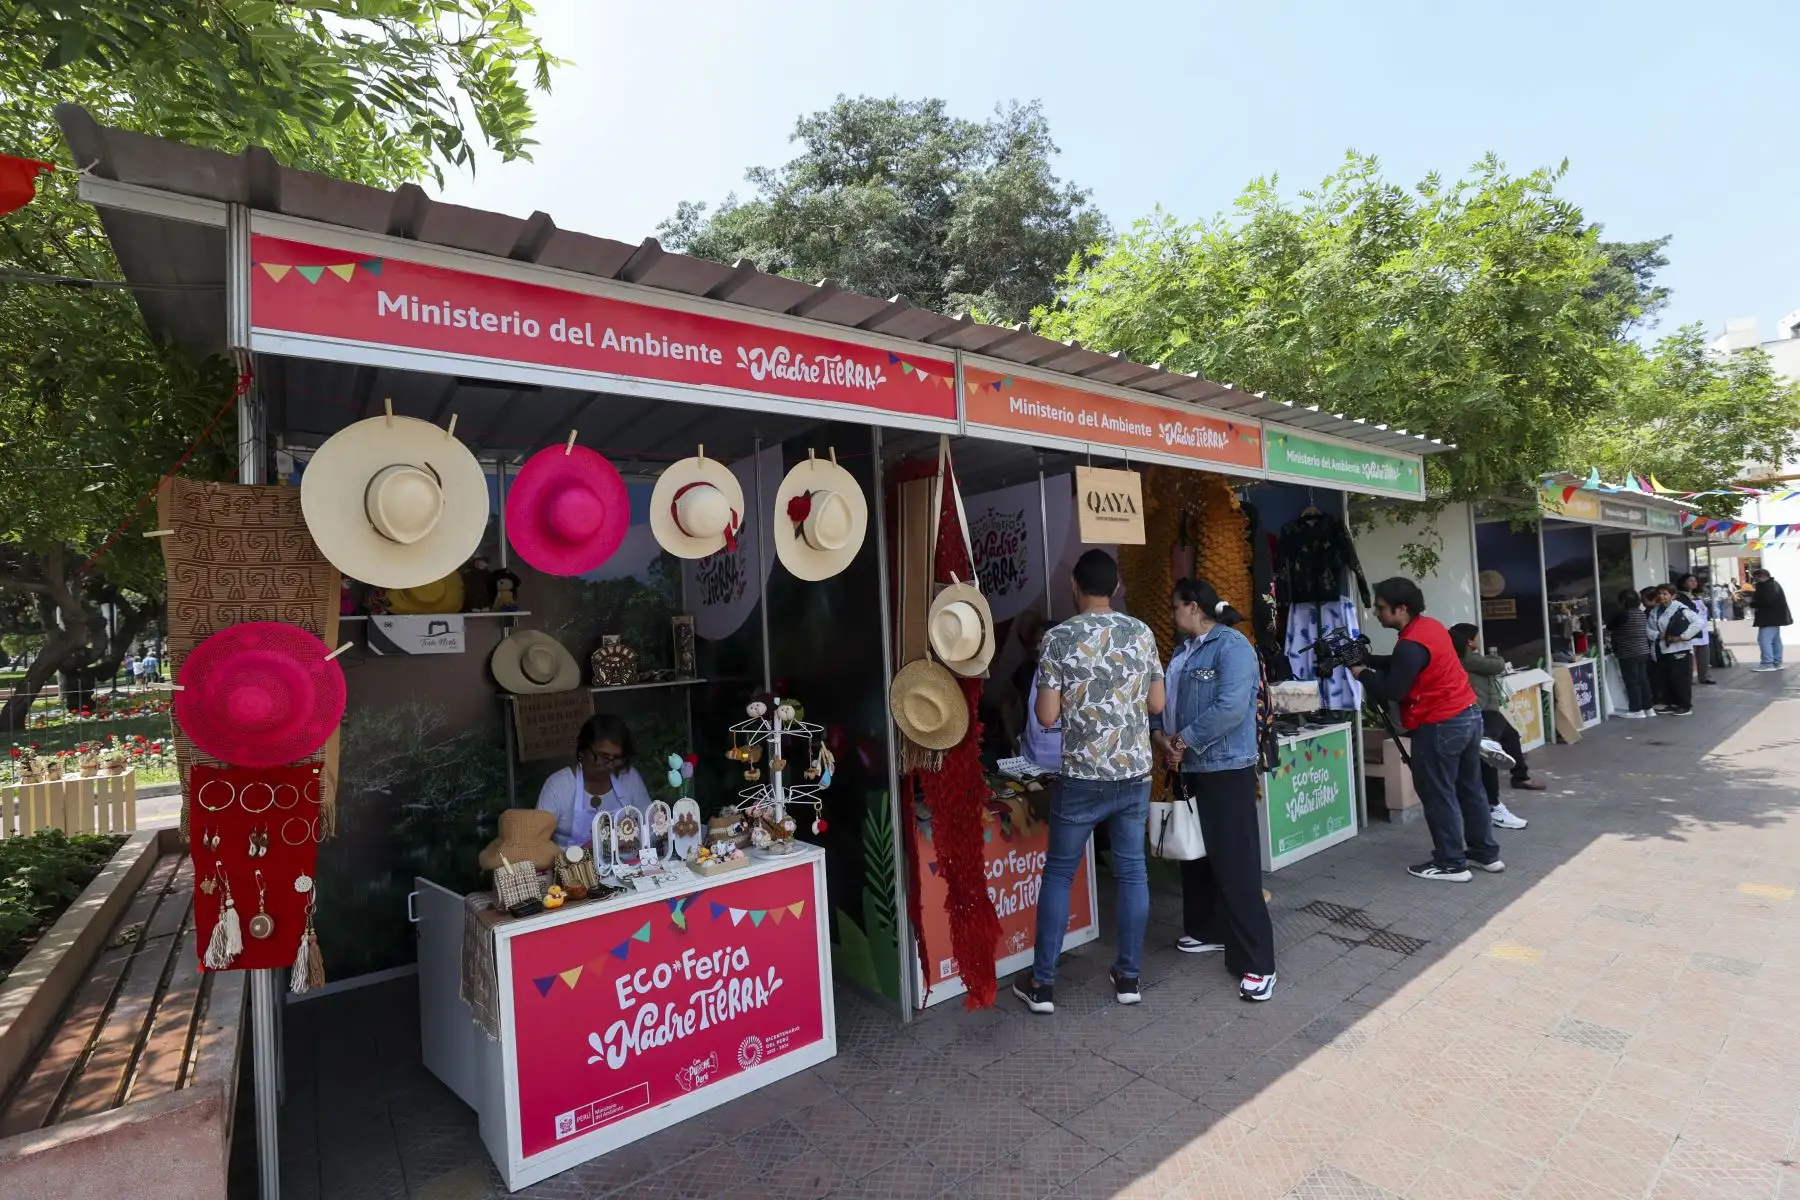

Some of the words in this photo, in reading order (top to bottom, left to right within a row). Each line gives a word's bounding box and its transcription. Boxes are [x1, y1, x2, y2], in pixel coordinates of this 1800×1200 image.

[377, 290, 540, 338] Ministerio
[550, 318, 595, 348] del
[600, 327, 723, 366] Ambiente
[749, 345, 820, 383] Madre
[1009, 396, 1074, 424] Ministerio
[1077, 410, 1099, 428] del
[1101, 413, 1152, 437] Ambiente
[1164, 421, 1196, 446] Madre
[1286, 449, 1320, 467] Ministerio
[1087, 490, 1137, 514] QAYA
[604, 1002, 697, 1070] Madre
[576, 1111, 591, 1123] PERÚ
